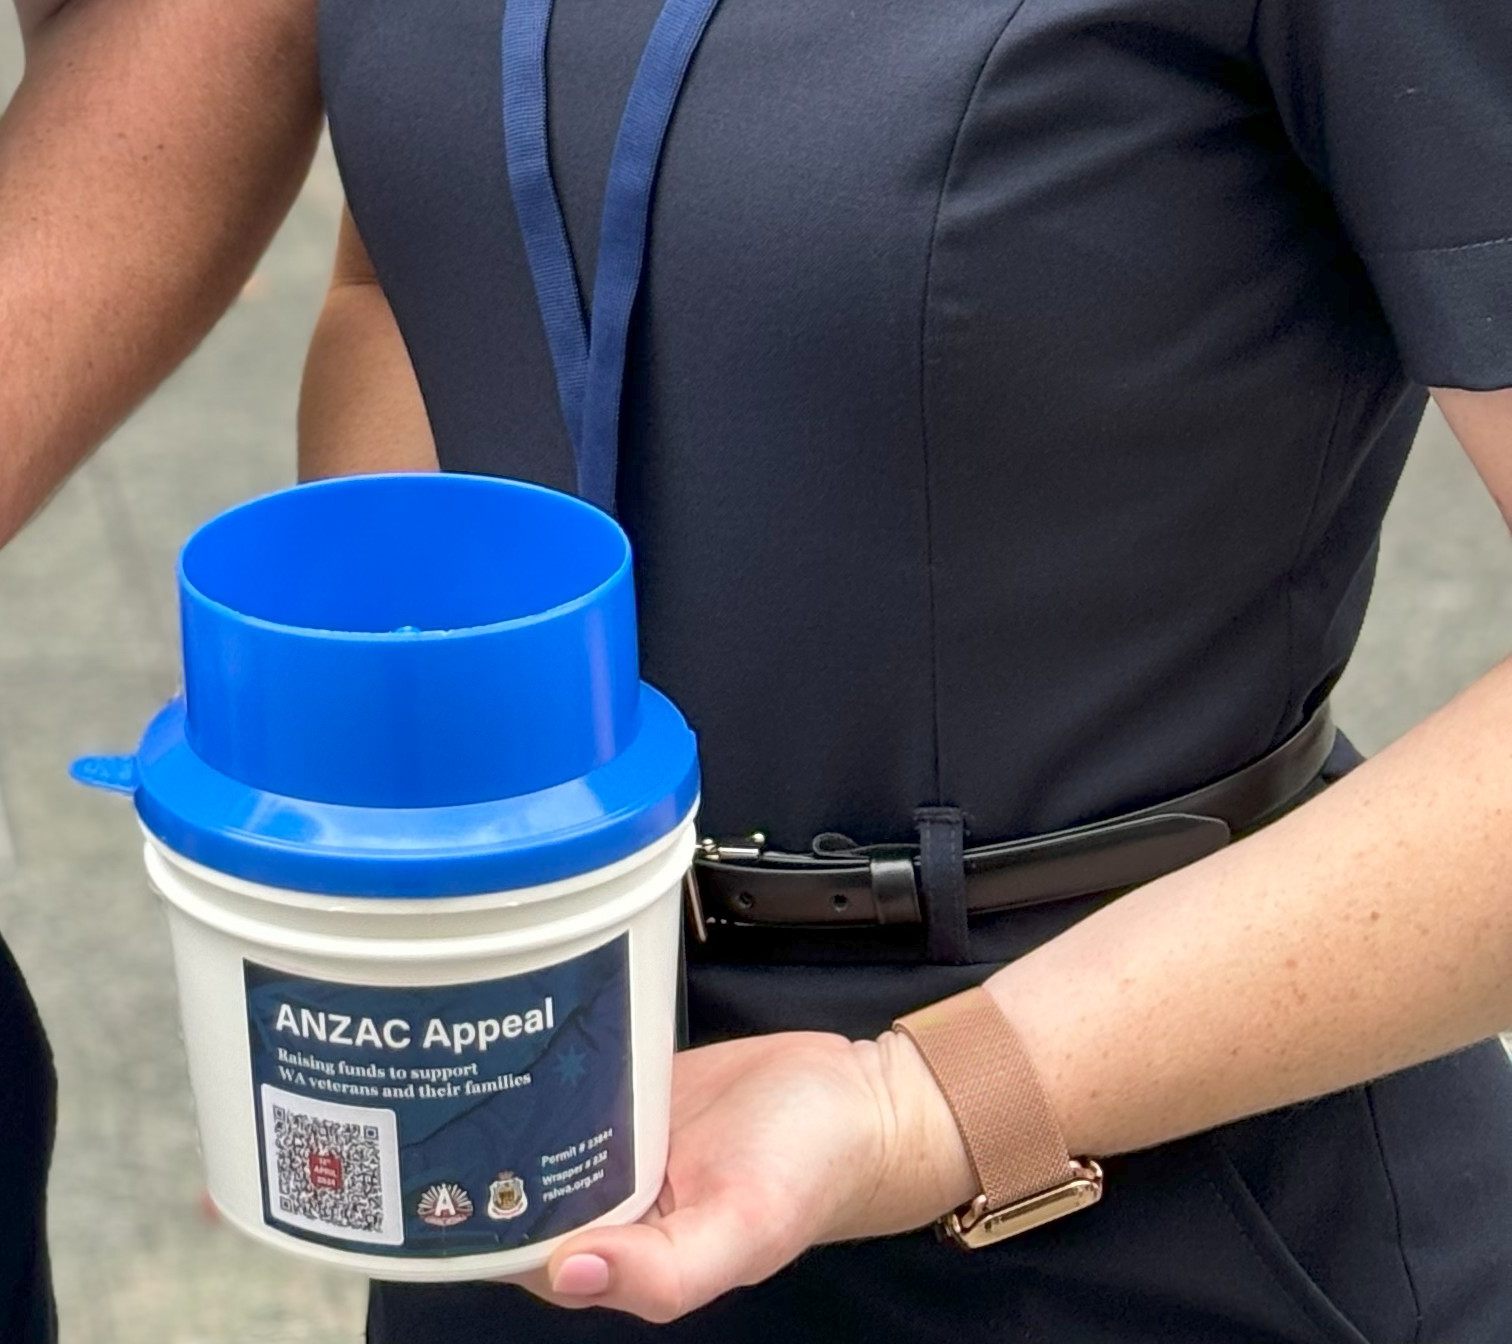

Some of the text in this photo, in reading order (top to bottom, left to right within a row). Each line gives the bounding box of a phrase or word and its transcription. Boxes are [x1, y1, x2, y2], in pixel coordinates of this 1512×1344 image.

[274, 996, 556, 1054] ANZAC Appeal
[277, 1047, 479, 1084] Raising funds to support
[278, 1065, 532, 1099] WA veterans and their families
[541, 1145, 577, 1168] Permit
[542, 1163, 584, 1186] Wrapper
